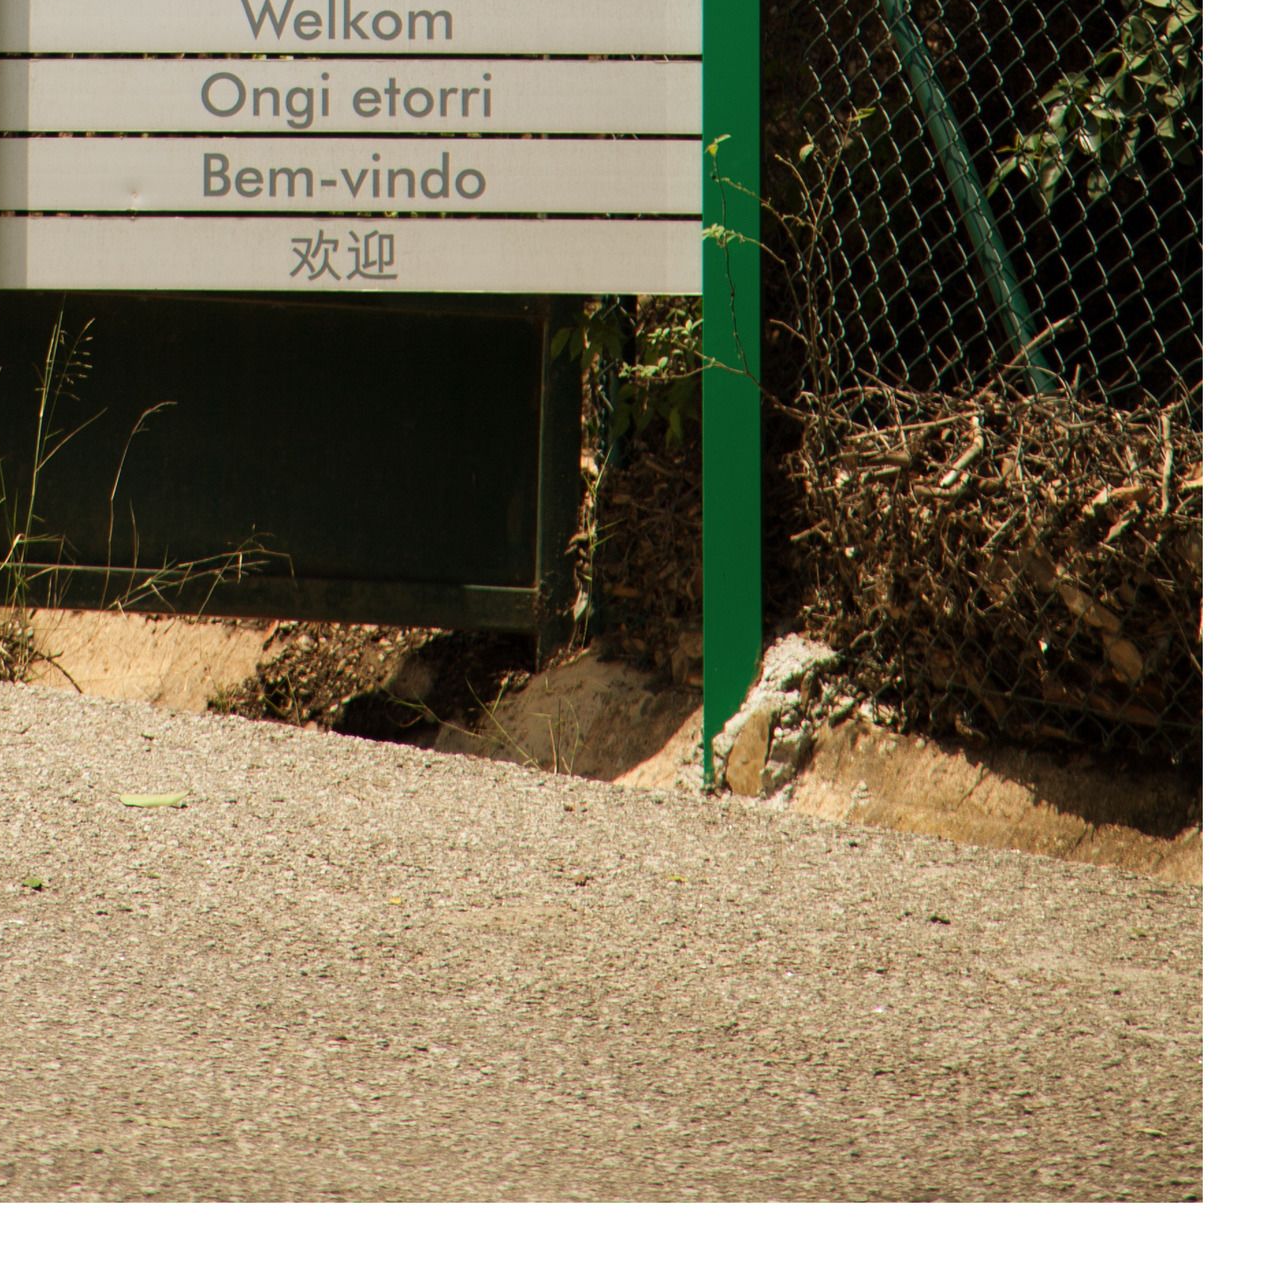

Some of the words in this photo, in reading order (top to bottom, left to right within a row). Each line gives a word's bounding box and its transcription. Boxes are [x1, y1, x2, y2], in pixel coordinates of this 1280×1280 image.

[200, 72, 330, 129] Ongi
[353, 73, 491, 118] etorri
[204, 152, 486, 199] Bem-vindo
[290, 230, 397, 280] 欢迎
